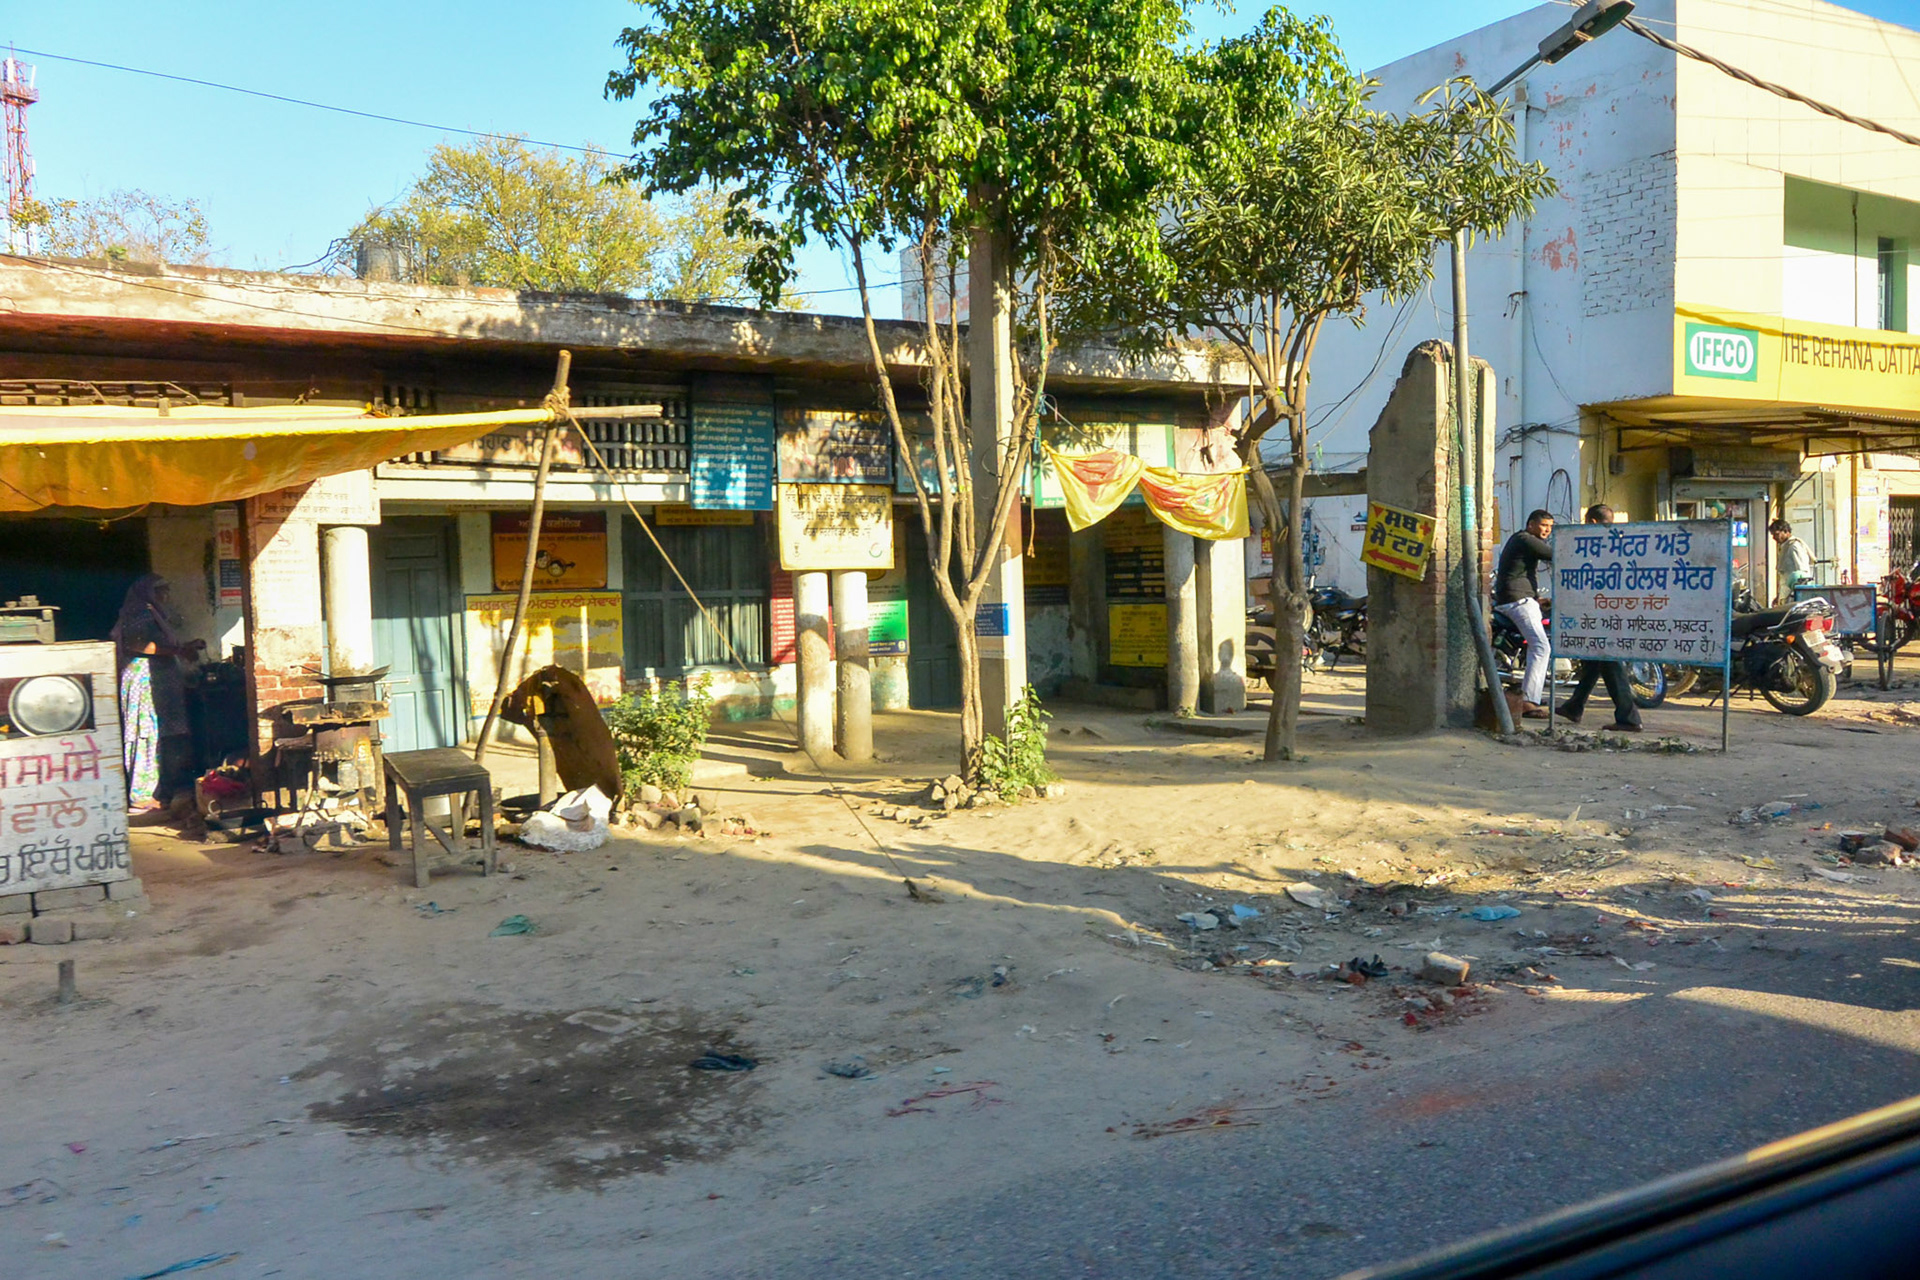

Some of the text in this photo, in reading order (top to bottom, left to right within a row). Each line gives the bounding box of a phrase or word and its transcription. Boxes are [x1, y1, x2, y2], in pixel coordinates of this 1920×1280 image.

[1696, 336, 1748, 369] IFFCO
[1782, 333, 1809, 365] THE
[1813, 337, 1873, 371] REHANA
[1385, 509, 1420, 533] ਸਬ
[1370, 521, 1425, 557] ਸੈਂਟਰ
[1655, 526, 1692, 557] ਅਤੇ
[1560, 558, 1717, 591] ਸਬਸਿਡਰੀ ਹੈਲਥ ਸੈਂਟਰ
[469, 598, 518, 612] ਗਰਭਵਤ
[1593, 593, 1670, 610] ਰਿਹਾਣਾ ਜੱਟਾਂ
[1580, 613, 1597, 630] ਗੇਟ
[1601, 614, 1623, 632] ਅੱਗੇ
[1639, 638, 1669, 652] ਕਰਨਾ
[16, 735, 101, 785] ਸਮੋਸੇ
[11, 786, 88, 834] ਵਾਲੇ
